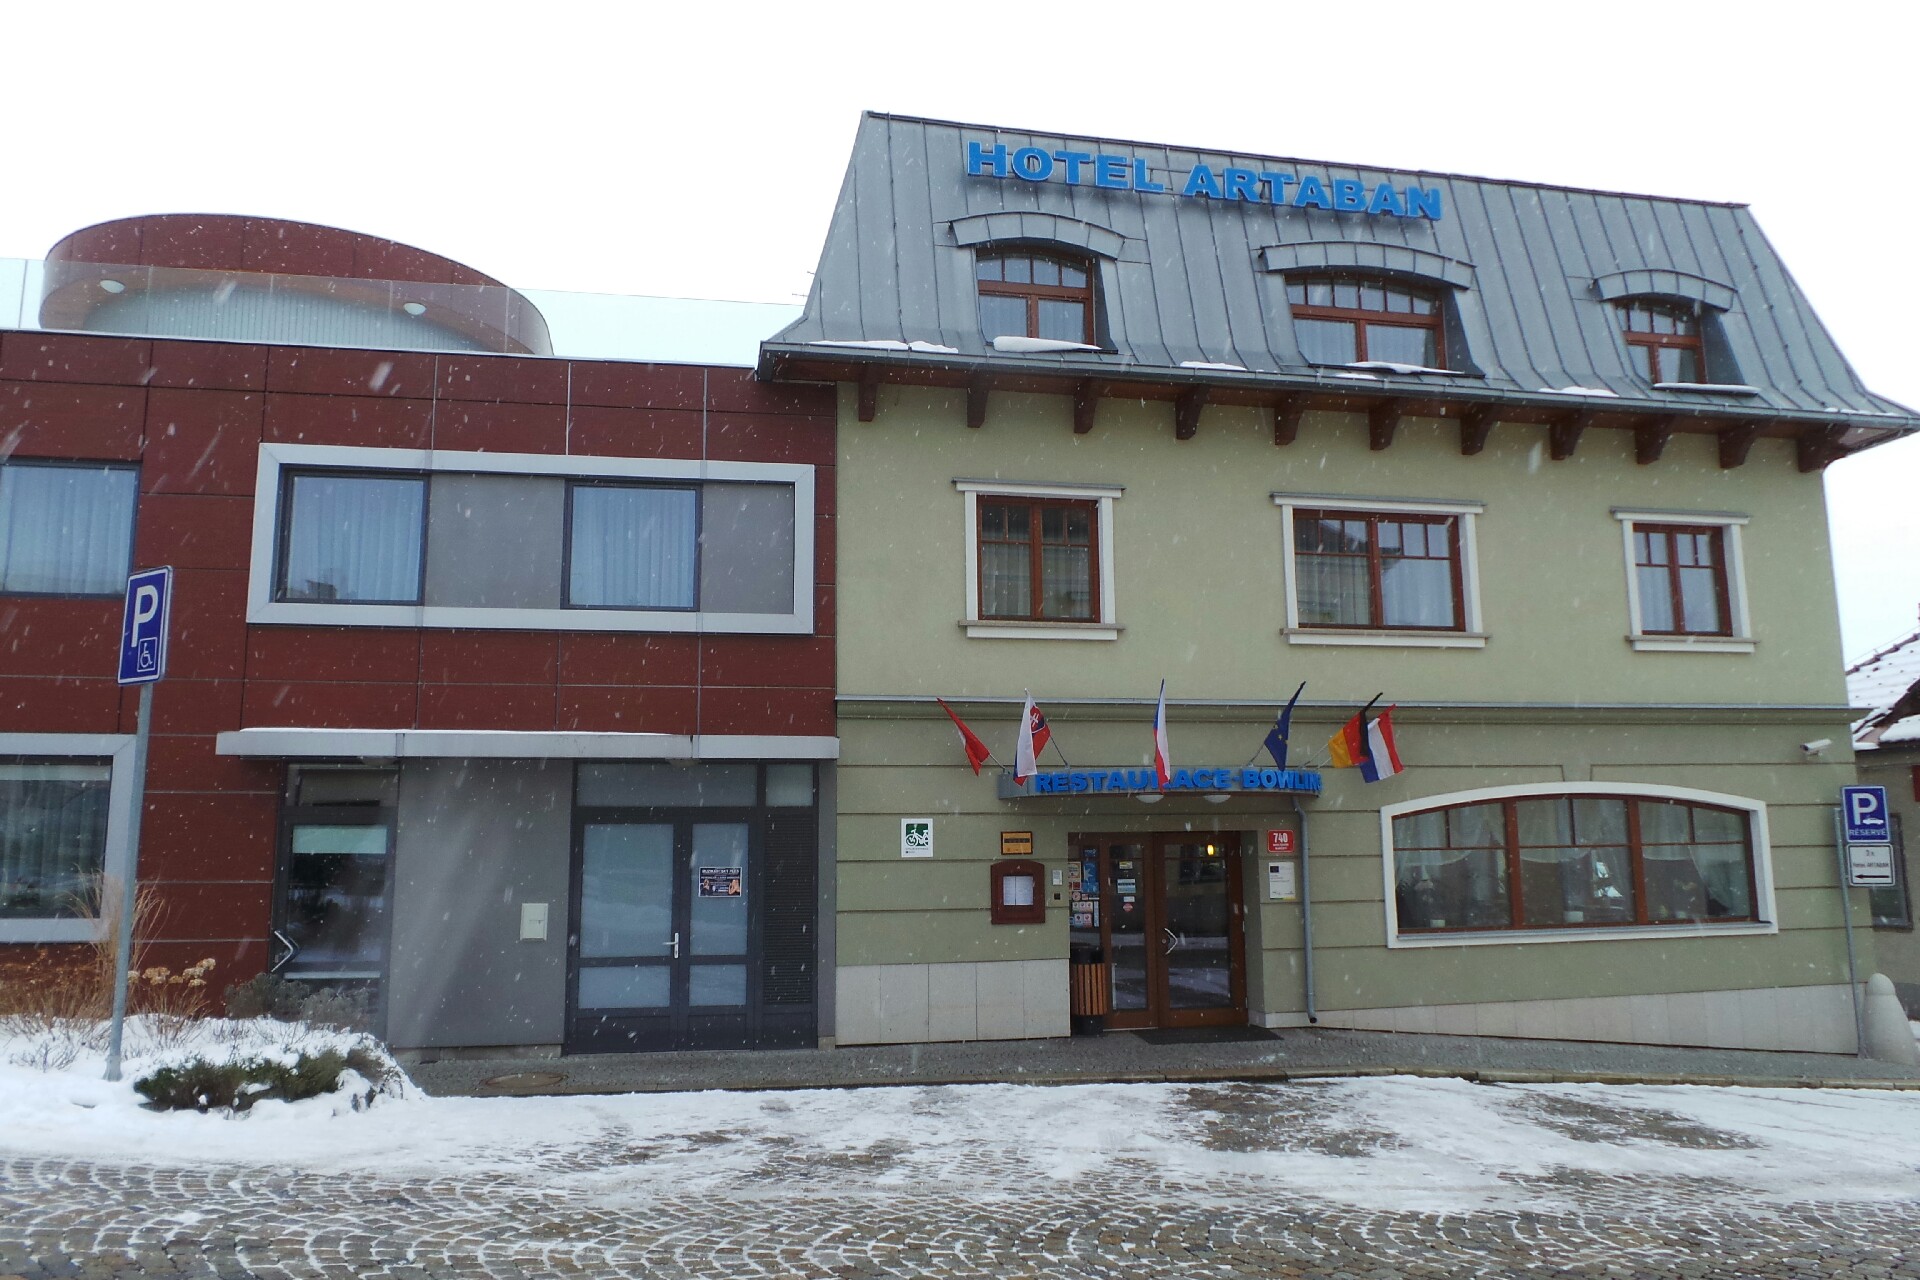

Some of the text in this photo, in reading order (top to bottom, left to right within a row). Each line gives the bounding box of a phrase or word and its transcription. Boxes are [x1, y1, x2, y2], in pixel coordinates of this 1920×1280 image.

[967, 141, 1442, 221] HOTEL ARTABAN
[131, 584, 159, 648] P
[1852, 792, 1878, 825] P
[1273, 832, 1288, 843] 740
